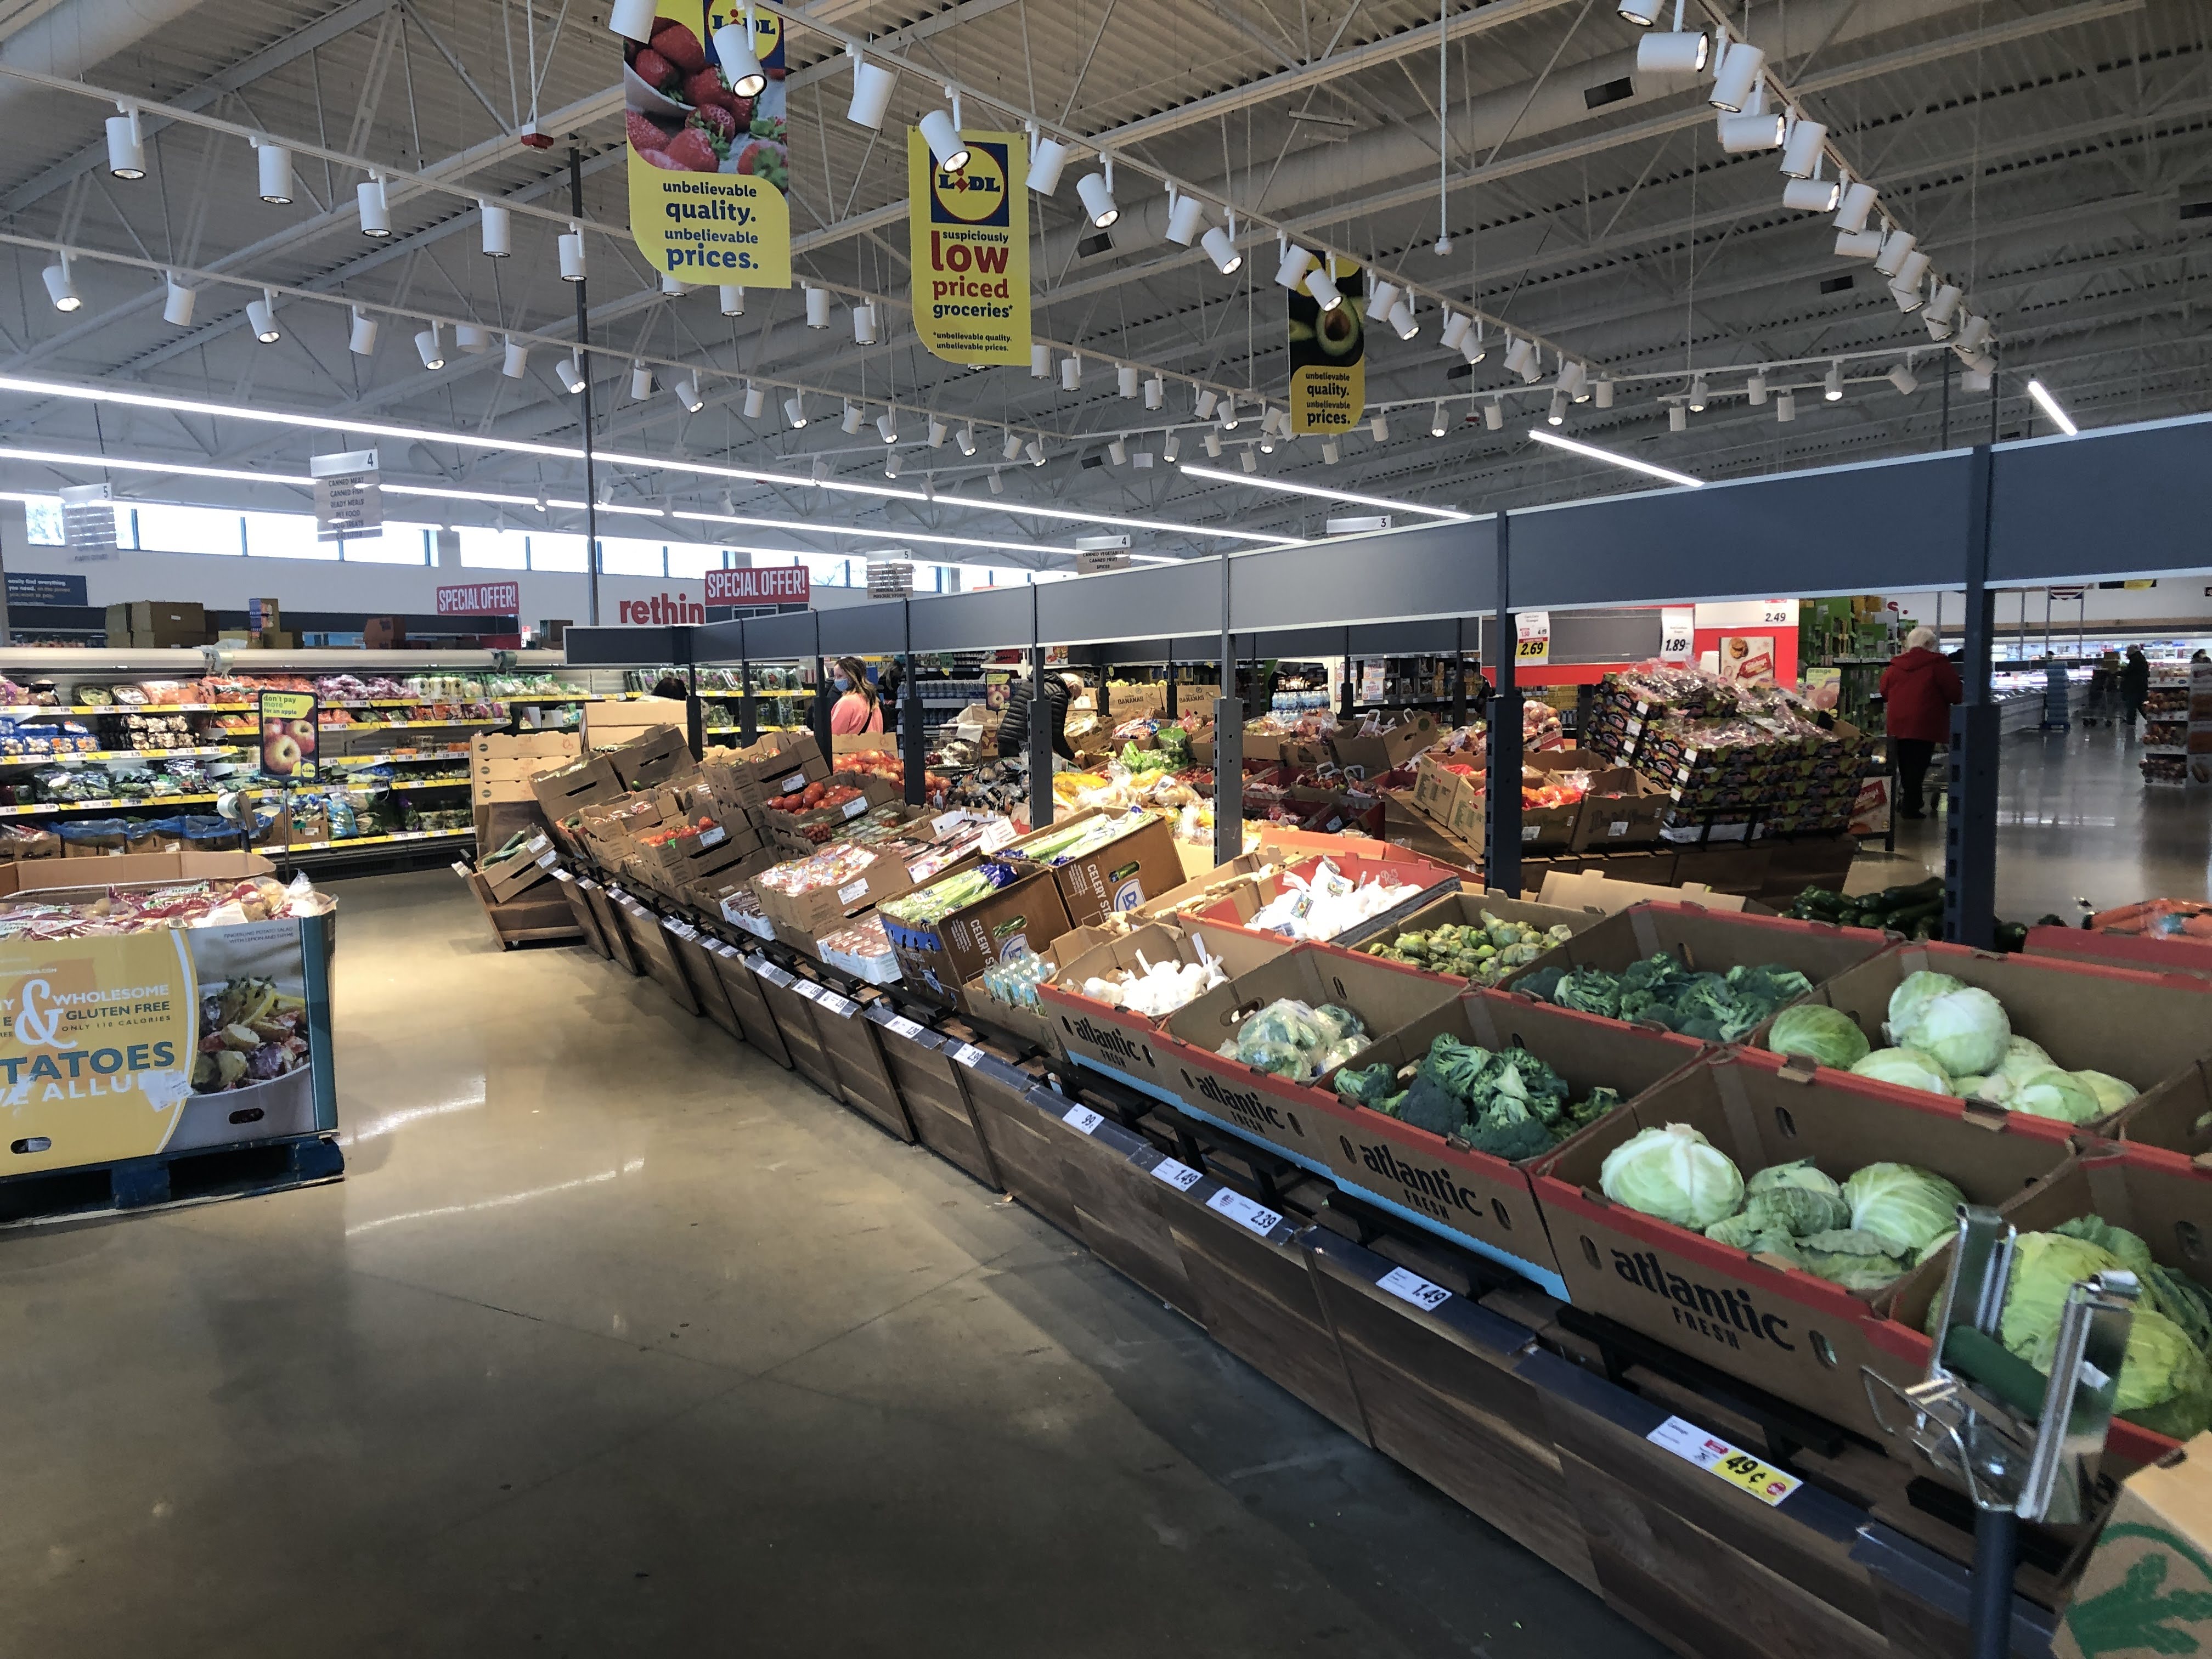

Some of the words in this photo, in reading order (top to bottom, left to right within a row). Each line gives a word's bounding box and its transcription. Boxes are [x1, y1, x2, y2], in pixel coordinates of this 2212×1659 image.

[663, 181, 757, 197] unbelievable
[939, 168, 1000, 194] LIDL
[665, 200, 756, 226] quality.
[664, 228, 758, 244] unbelievable
[943, 230, 1009, 244] suspiciously
[666, 242, 759, 270] prices.
[931, 230, 1009, 274] low
[932, 275, 1009, 301] priced
[985, 343, 1009, 352] prices.
[1306, 371, 1350, 382] unbelievable
[1307, 382, 1350, 399] quality.
[1306, 400, 1350, 409] unbelievable
[1307, 409, 1351, 426] prices.
[367, 453, 374, 467] 4
[103, 486, 108, 498] 5
[1380, 518, 1386, 528] 3
[1121, 537, 1127, 546] 4
[904, 551, 909, 559] 5
[708, 571, 759, 599] SPECIAL
[761, 569, 806, 596] OFFER!
[439, 588, 479, 612] SPECIAL
[481, 585, 516, 610] OFFER!
[1765, 612, 1786, 622] 2.49
[1520, 642, 1544, 656] 2.69
[1666, 639, 1686, 651] 1.89
[1118, 696, 1144, 705] BANANAS
[1179, 695, 1205, 703] BANANAS
[1087, 864, 1107, 900] CELERY
[969, 918, 992, 956] CELERY
[15, 979, 78, 1049] &
[52, 984, 169, 1006] WHOLESOME
[65, 1006, 130, 1020] GLUTEN
[134, 1001, 171, 1014] FREE
[61, 1024, 89, 1032] ONLY
[119, 1015, 171, 1026] CALORIES
[1073, 1017, 1141, 1061] atlantic
[0, 1041, 175, 1085] TATOES
[1194, 1075, 1285, 1129] atlantic
[1173, 1169, 1199, 1185] 1.49
[1359, 1144, 1483, 1217] atlantic
[1250, 1210, 1277, 1228] 2.39
[1412, 1284, 1447, 1303] 1.49
[1611, 1249, 1796, 1351] atlantic
[1673, 1306, 1741, 1350] FRESH
